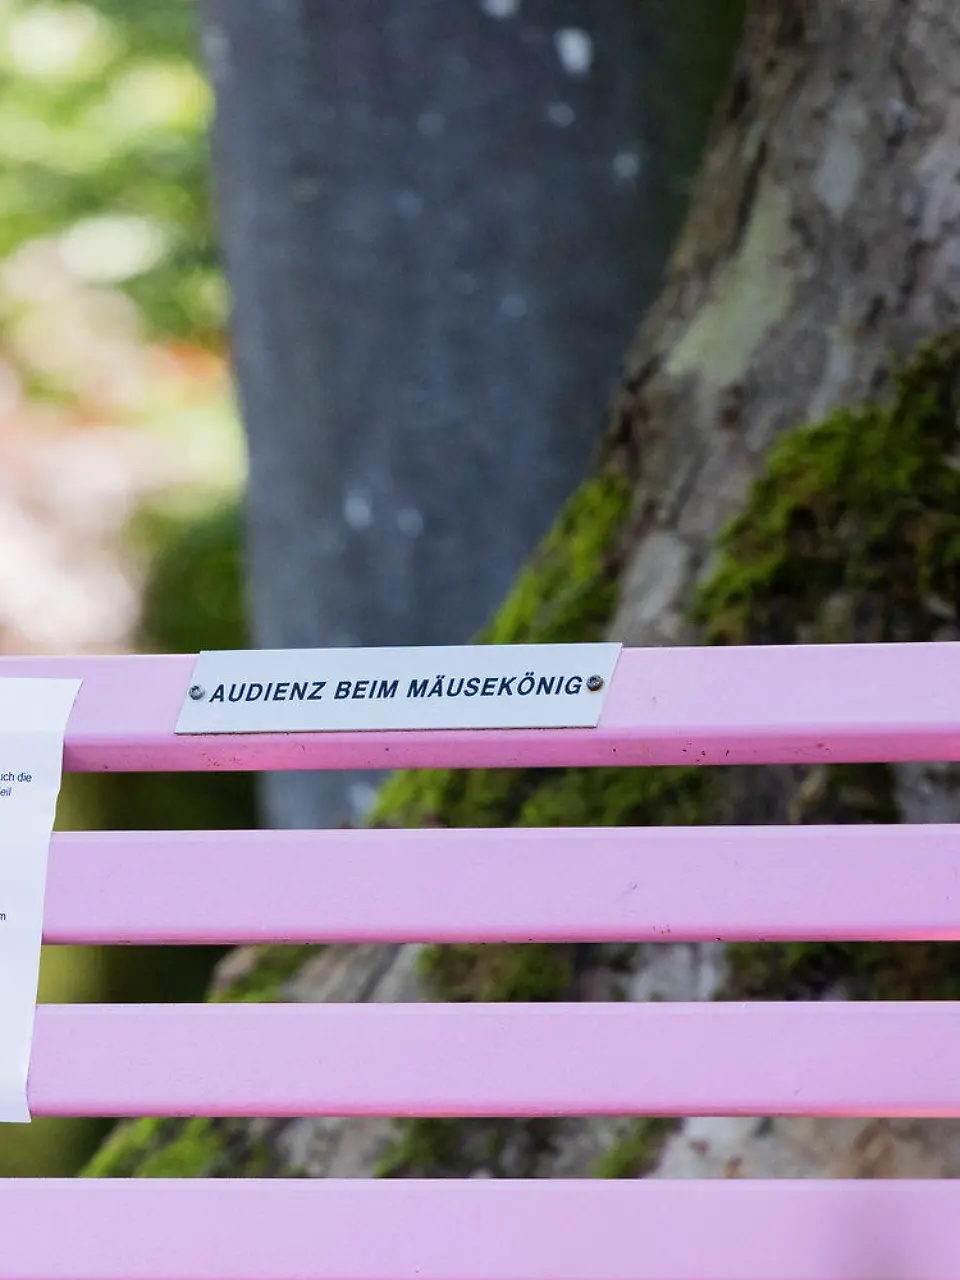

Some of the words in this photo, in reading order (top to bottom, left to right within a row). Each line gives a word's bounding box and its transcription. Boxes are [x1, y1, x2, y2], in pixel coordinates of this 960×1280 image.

[209, 681, 326, 703] AUDIENZ
[334, 679, 399, 700] BEIM
[406, 671, 584, 699] MÄUSEKÖNIG
[17, 772, 32, 782] die
